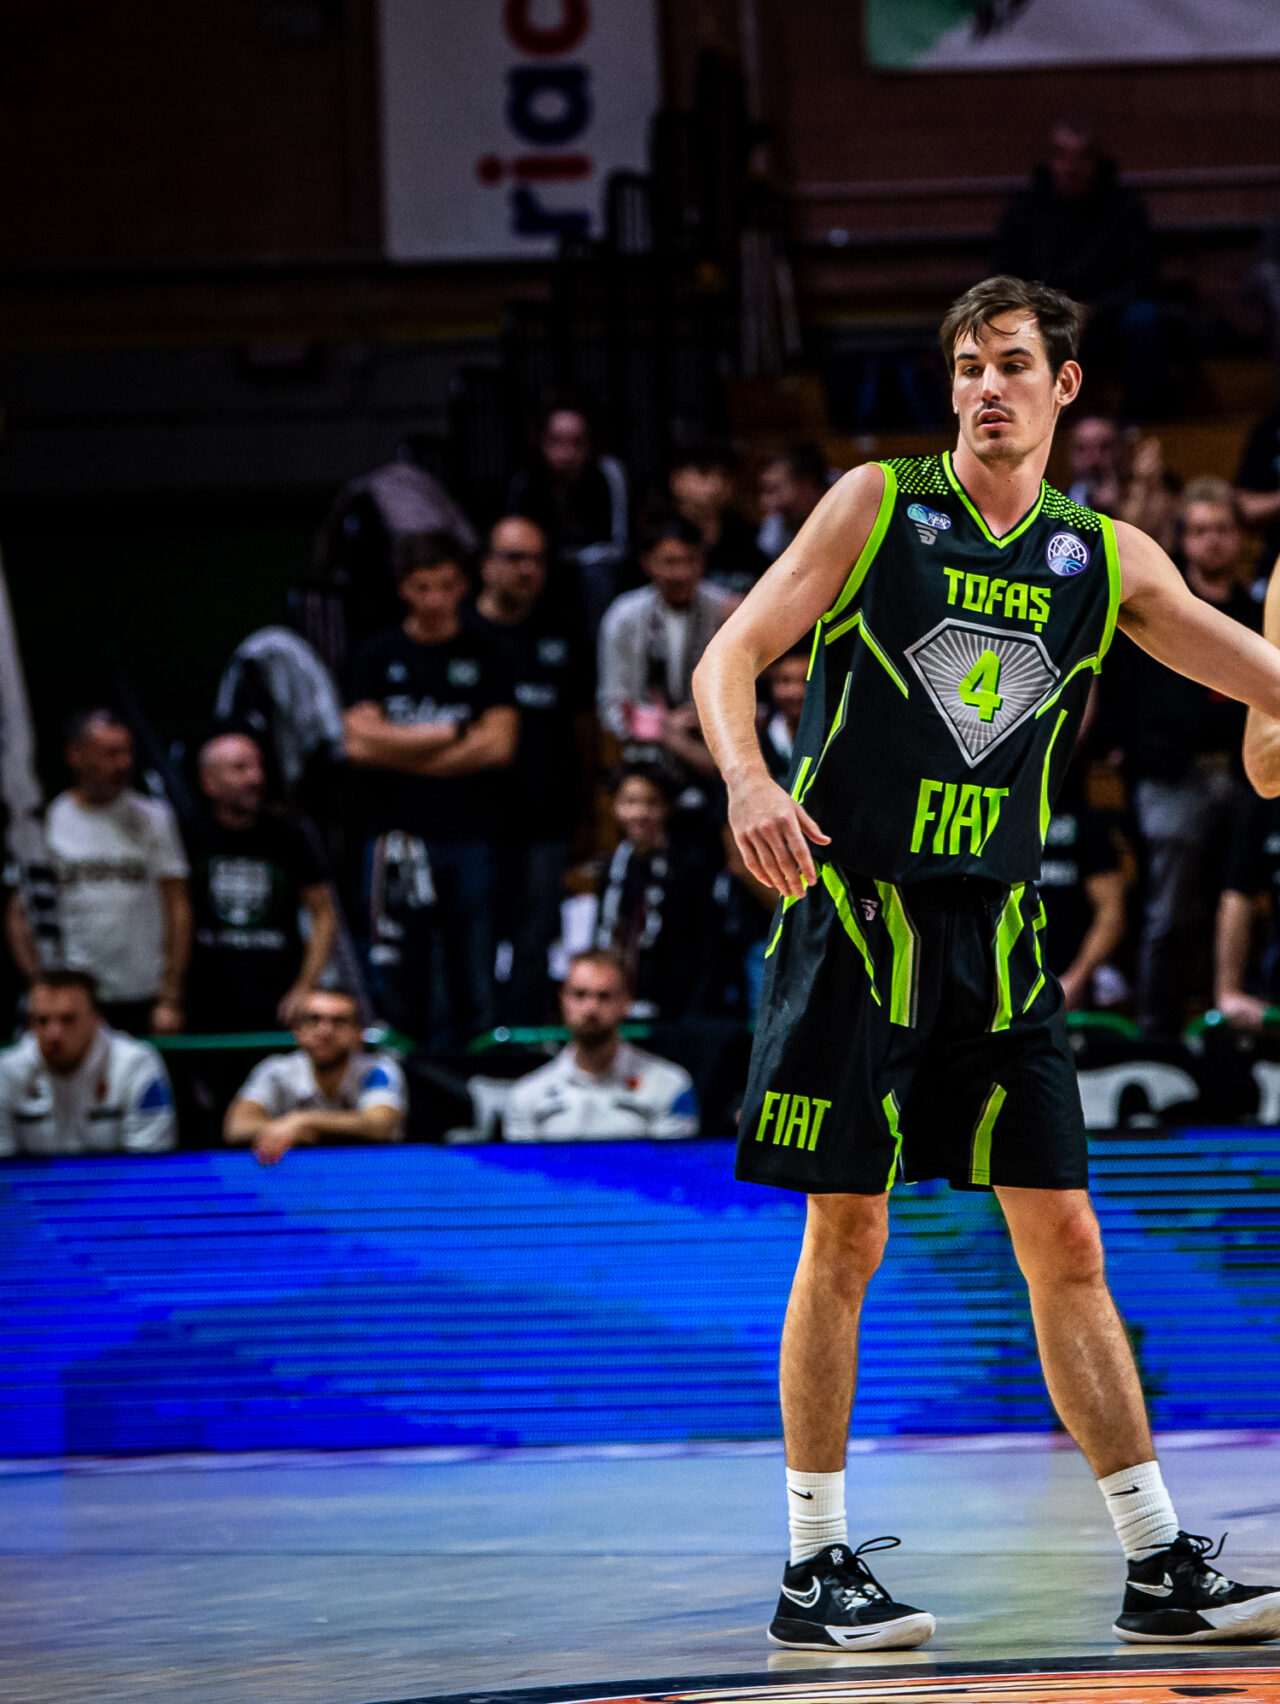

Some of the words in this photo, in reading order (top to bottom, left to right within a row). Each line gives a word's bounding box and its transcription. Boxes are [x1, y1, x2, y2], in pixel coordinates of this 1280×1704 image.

[943, 567, 1052, 633] TOFAŞ
[958, 650, 1003, 722] 4
[910, 778, 1010, 857] FIAT
[755, 1090, 833, 1152] FIAT
